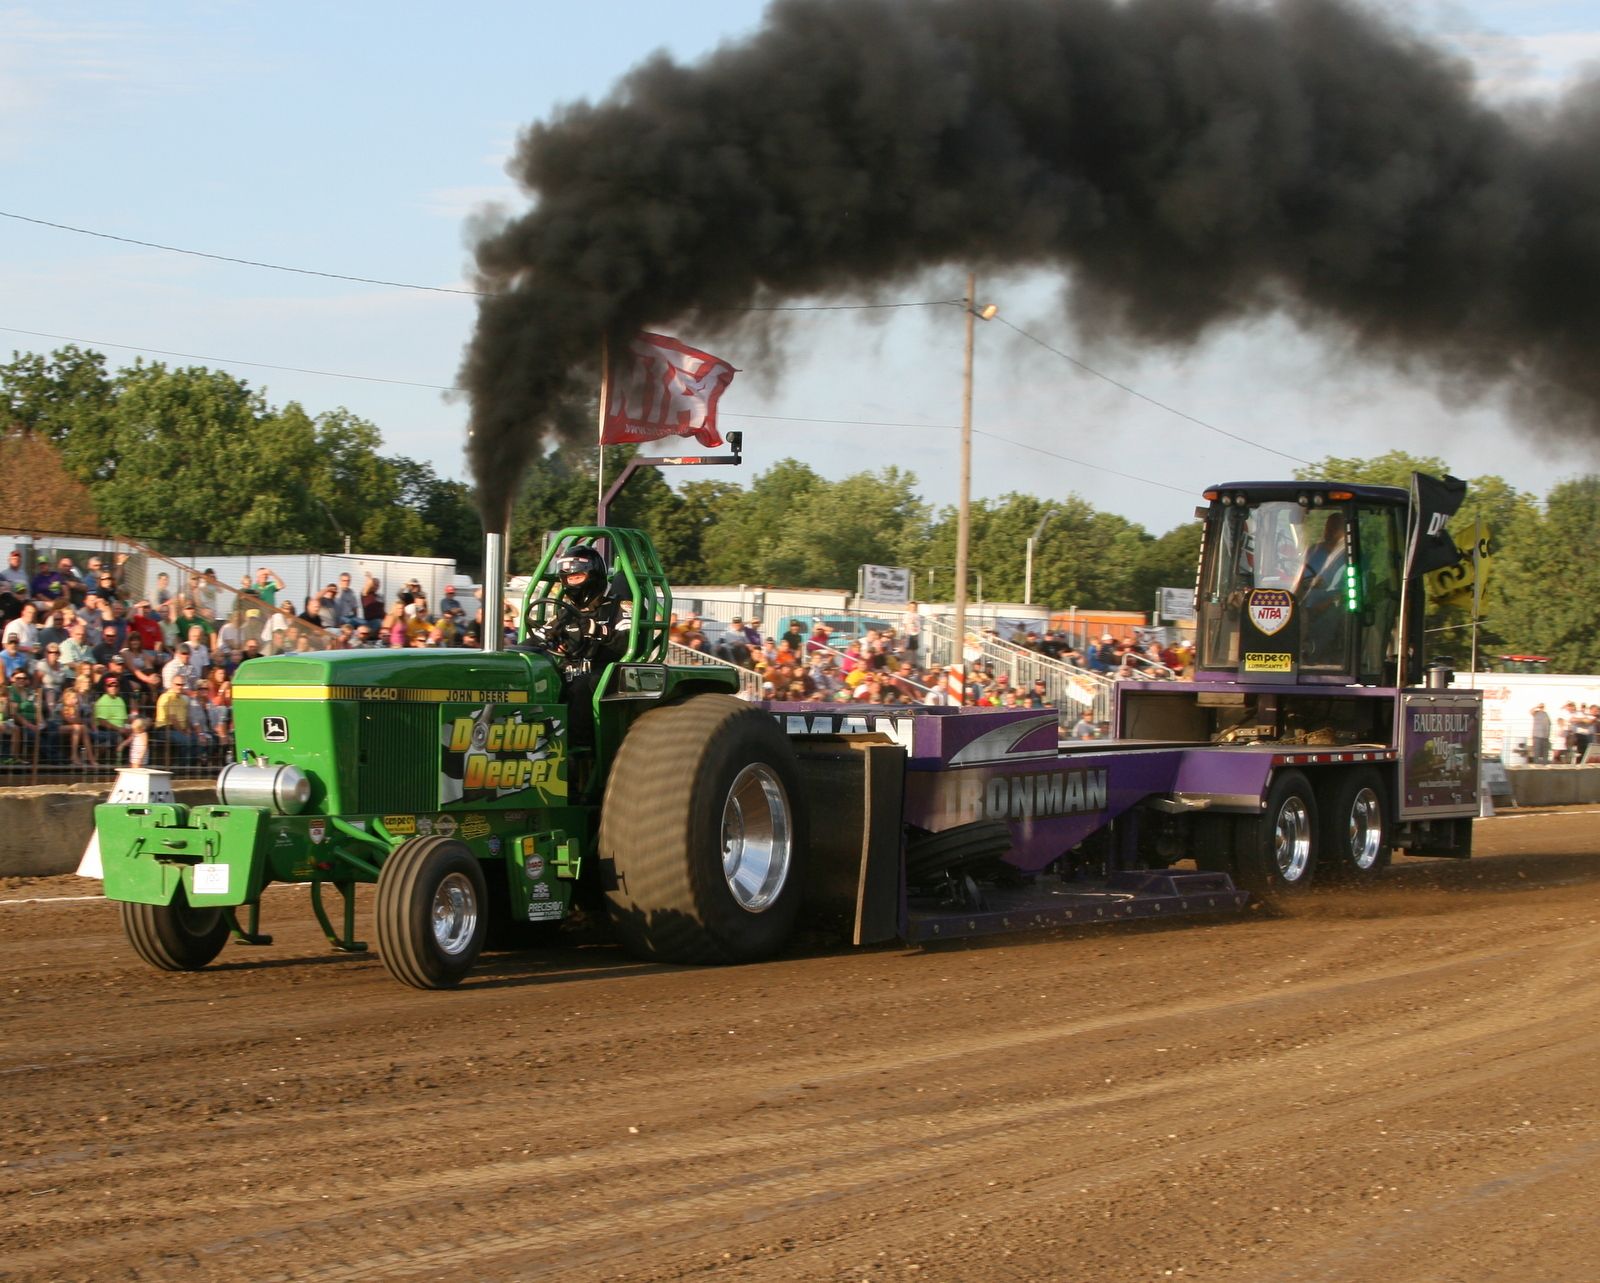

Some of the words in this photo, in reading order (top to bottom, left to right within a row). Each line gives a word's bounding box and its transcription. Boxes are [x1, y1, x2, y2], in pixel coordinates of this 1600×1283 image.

[1257, 607, 1282, 620] NTPA
[363, 687, 398, 700] 4440
[446, 690, 473, 701] JOHN
[479, 691, 509, 702] DEERE
[1413, 713, 1444, 732] BAUER
[1444, 713, 1470, 732] BUILT
[451, 717, 546, 752] Doctor
[463, 754, 548, 789] Deere
[944, 769, 1107, 821] IRONMAN
[528, 901, 563, 912] PRECISION
